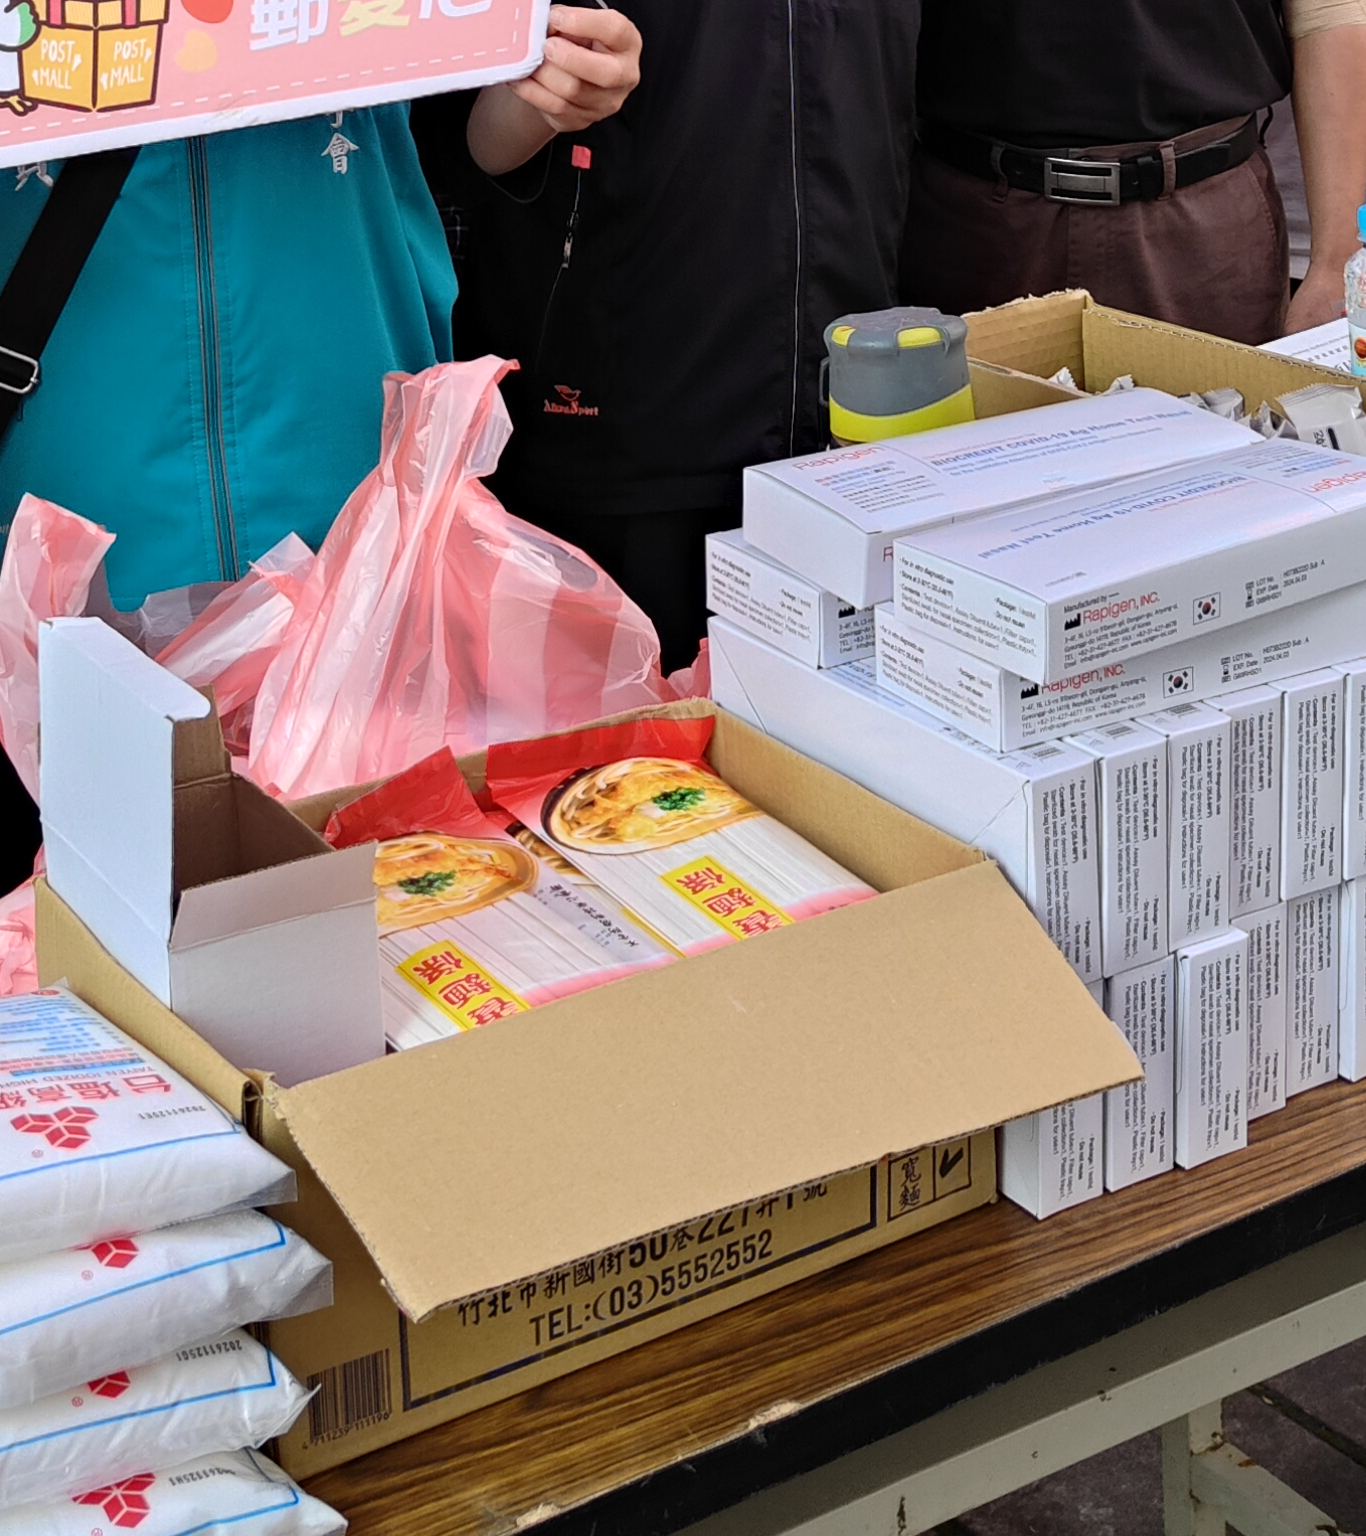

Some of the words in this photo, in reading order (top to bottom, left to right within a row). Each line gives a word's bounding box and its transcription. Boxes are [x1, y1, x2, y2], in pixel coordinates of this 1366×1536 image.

[39, 40, 75, 66] POST
[113, 36, 147, 61] POST
[39, 66, 74, 91] MALL
[109, 62, 146, 87] MALL
[1083, 596, 1138, 625] Rapigen,
